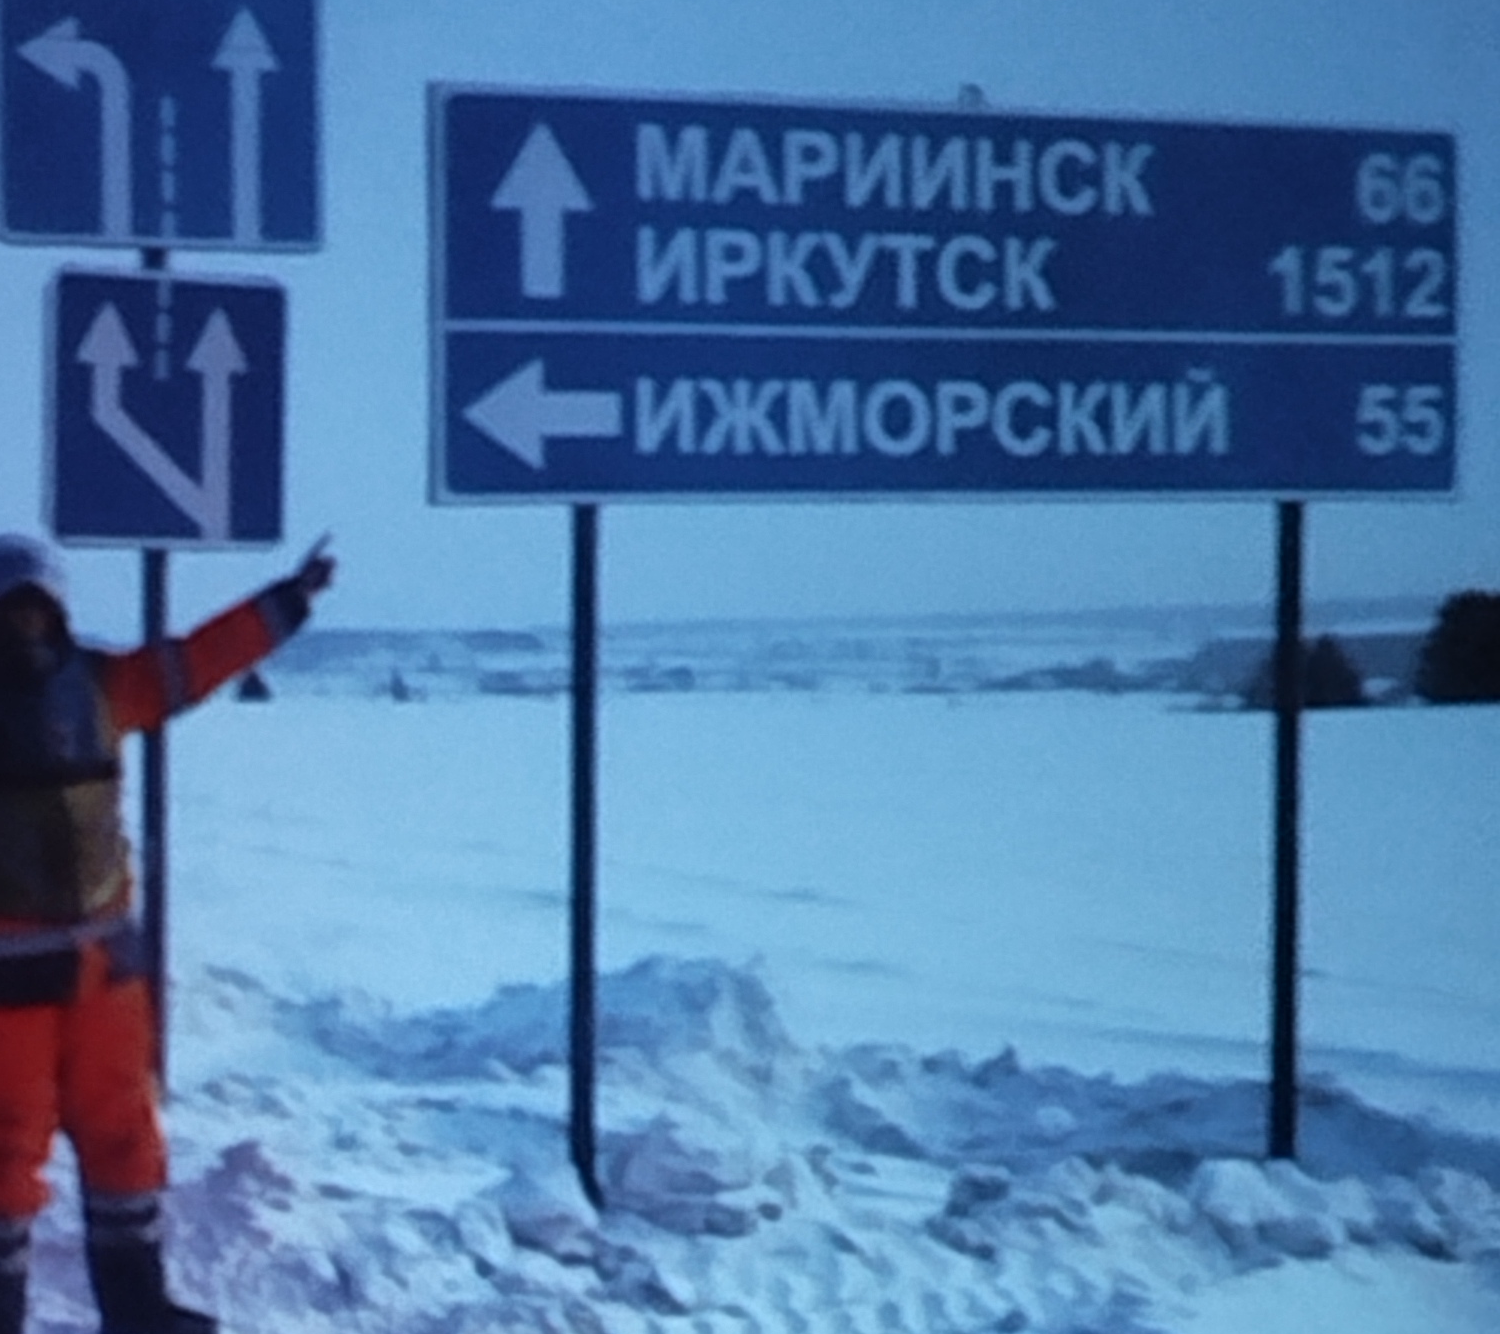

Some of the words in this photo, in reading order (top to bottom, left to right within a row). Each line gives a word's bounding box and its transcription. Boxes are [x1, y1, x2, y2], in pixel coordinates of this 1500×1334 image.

[635, 124, 1154, 216] МАРИИНСК
[1354, 152, 1447, 224] 66
[635, 228, 1057, 312] ИРКУТСК
[1267, 246, 1447, 319] 1512
[635, 368, 1230, 459] ИЖМОРСКИЙ
[1355, 385, 1446, 457] 55
